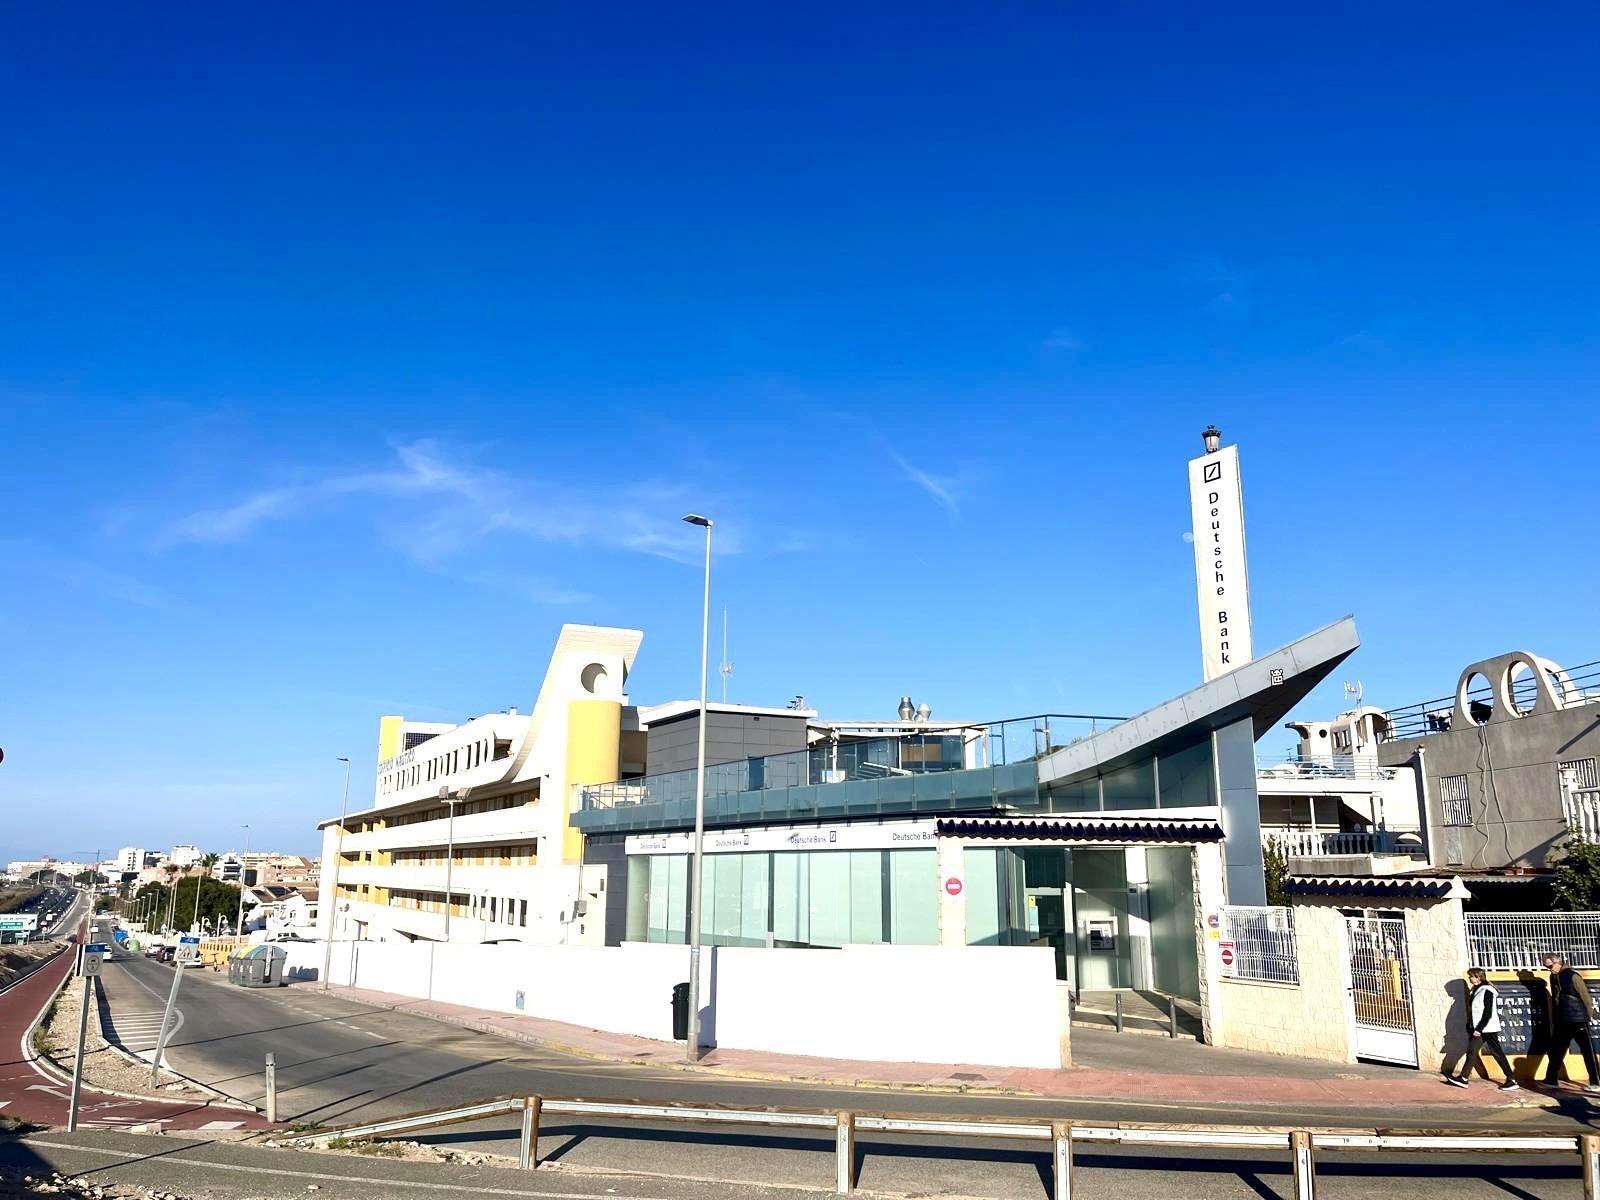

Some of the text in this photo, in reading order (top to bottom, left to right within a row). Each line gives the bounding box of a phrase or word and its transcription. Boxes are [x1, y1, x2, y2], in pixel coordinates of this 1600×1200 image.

[1208, 491, 1230, 664] Deutsche Bank
[790, 835, 827, 844] Deutsche Bank
[892, 831, 936, 841] Deutsche Ban
